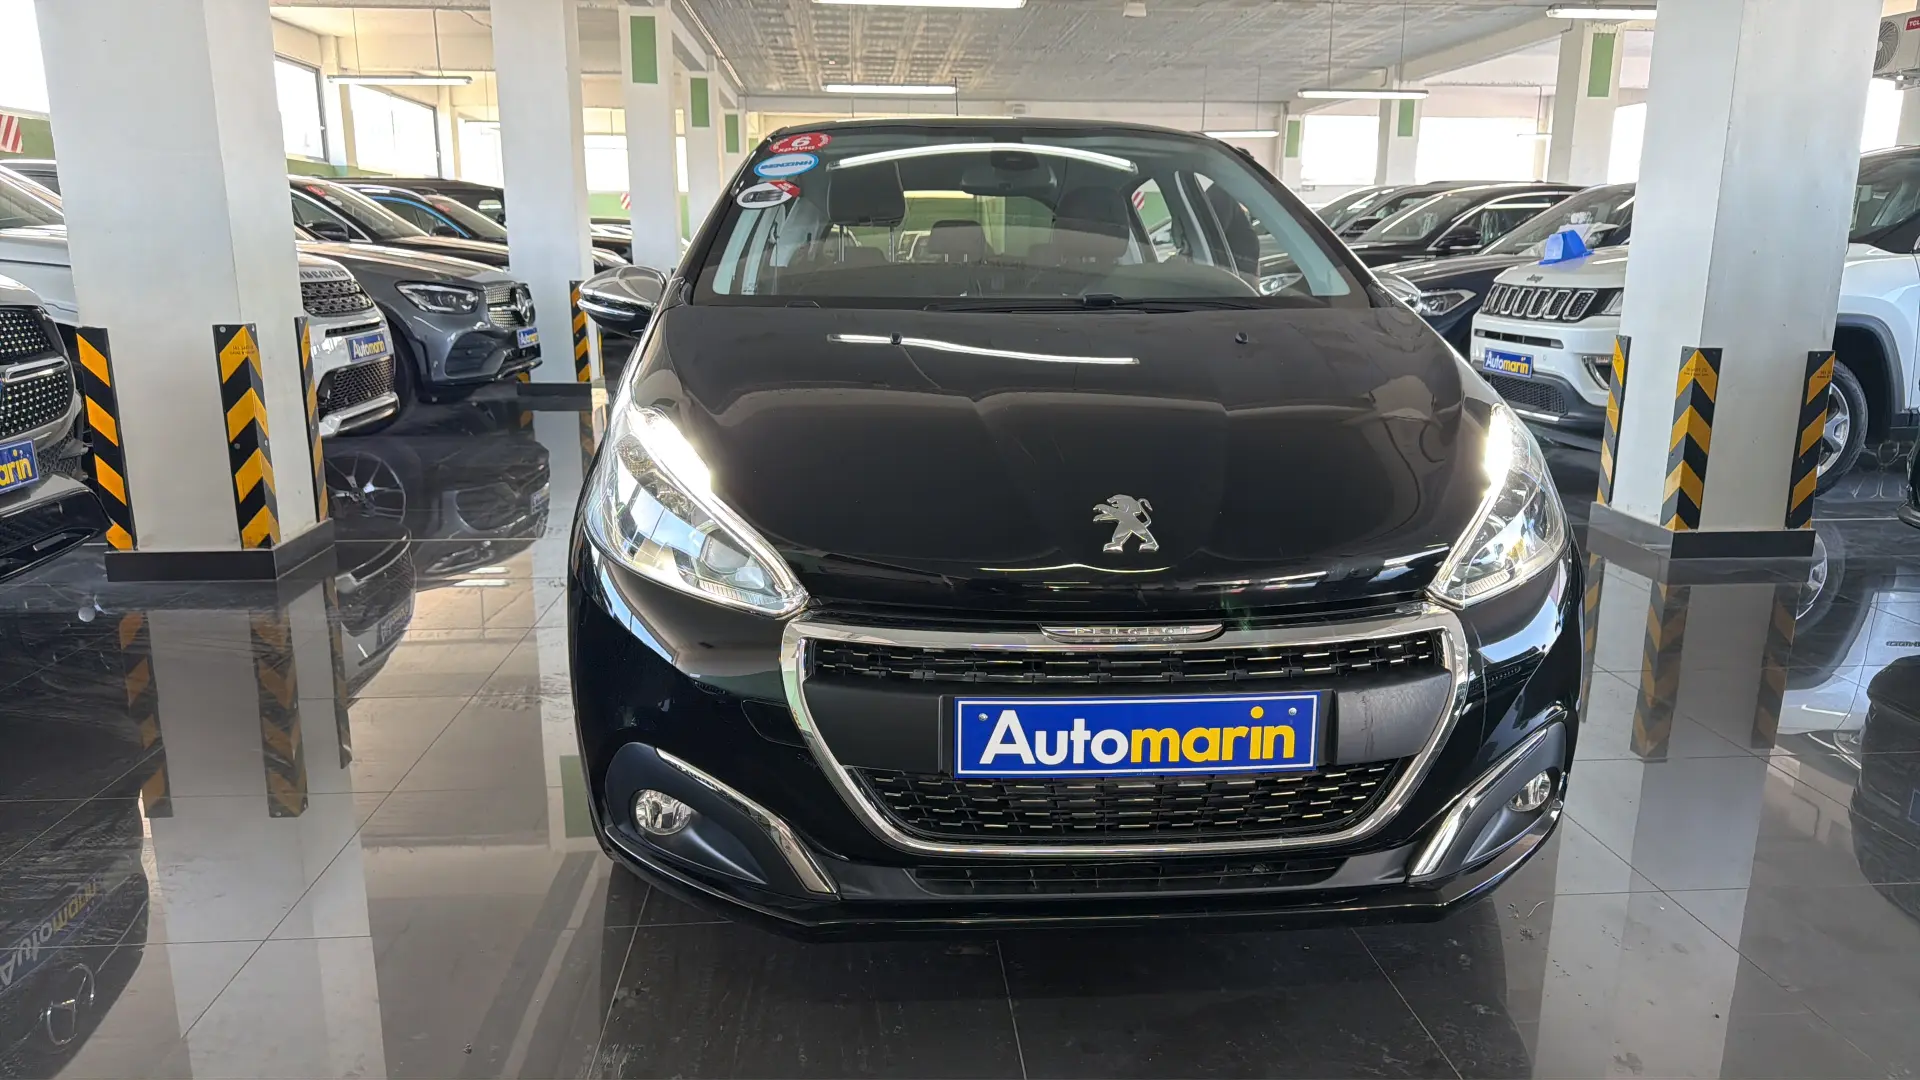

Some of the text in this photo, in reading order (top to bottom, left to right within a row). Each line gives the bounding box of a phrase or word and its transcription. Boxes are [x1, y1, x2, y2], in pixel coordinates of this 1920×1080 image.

[791, 136, 812, 147] 6
[353, 335, 385, 358] Automarin
[1485, 351, 1529, 374] Automarin
[979, 706, 1295, 765] Automarin
